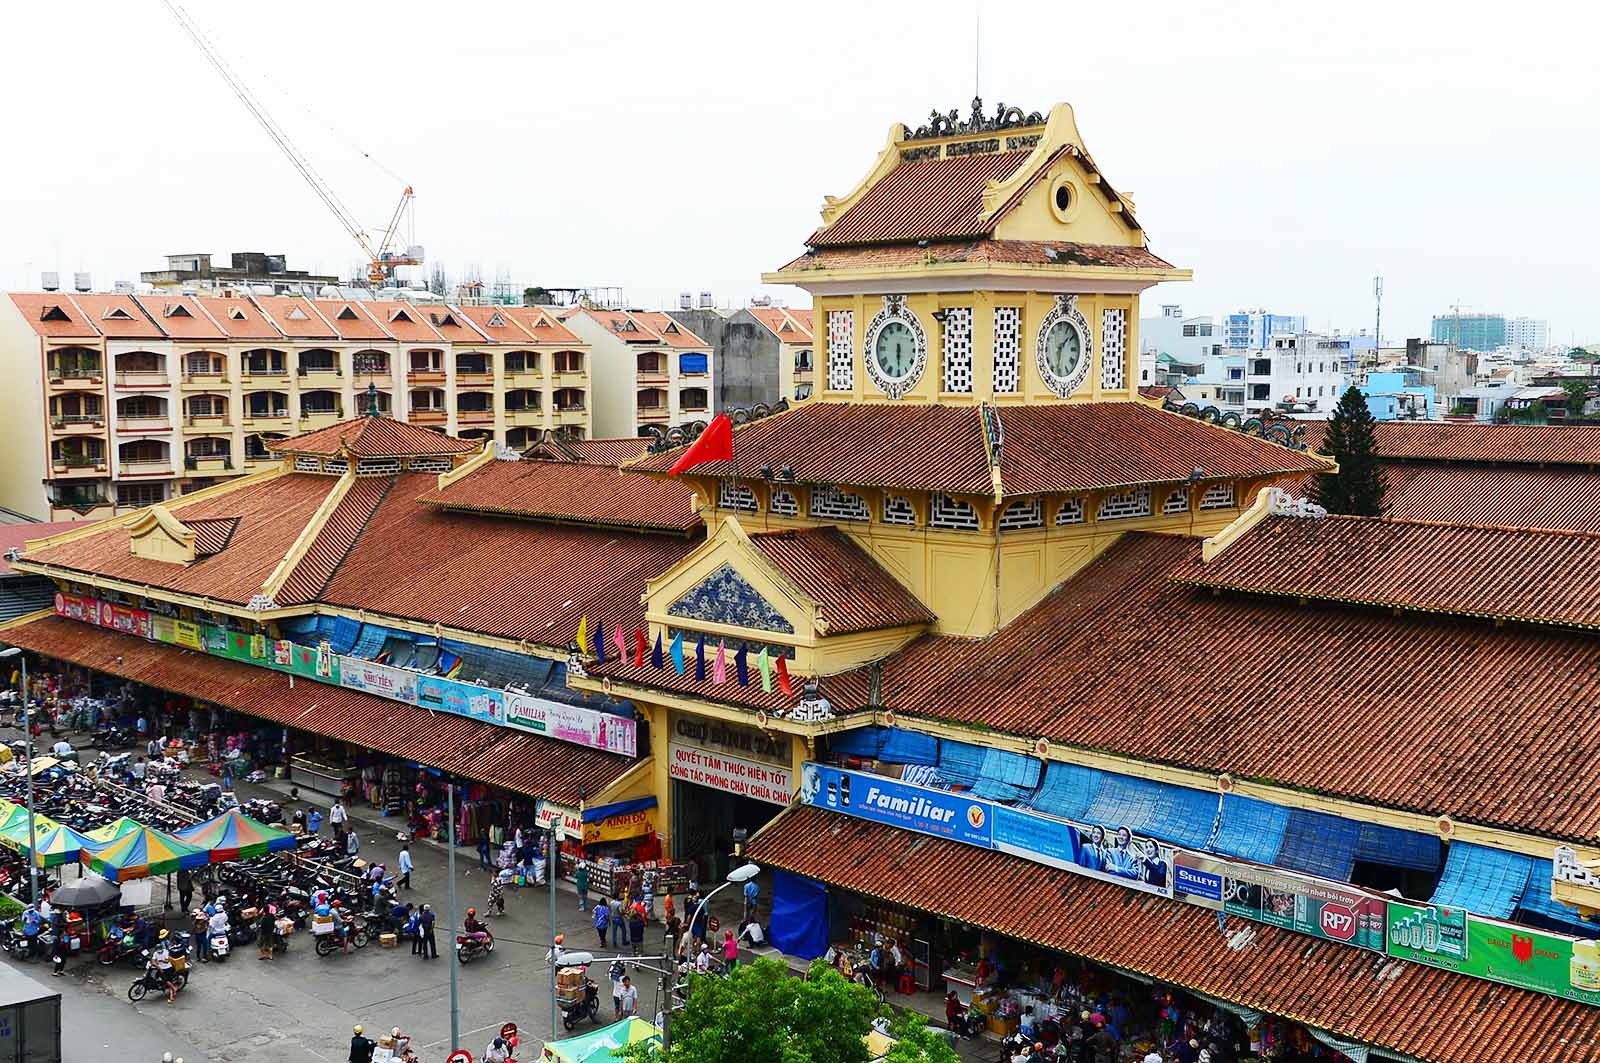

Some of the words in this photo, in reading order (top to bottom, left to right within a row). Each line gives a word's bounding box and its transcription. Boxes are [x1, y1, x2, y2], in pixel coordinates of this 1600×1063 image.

[514, 704, 546, 721] FAMILIAR
[670, 763, 689, 778] CÔNG
[690, 768, 704, 783] TÁC
[751, 784, 771, 800] CHỮA
[772, 787, 792, 805] CHÁY
[675, 749, 701, 765] QUYẾT
[703, 755, 721, 770] TÂM
[723, 760, 746, 777] THỰC
[747, 766, 768, 782] HIỆN
[770, 770, 787, 786] TỐT
[866, 787, 955, 823] Familiar
[1323, 911, 1352, 932] RP7
